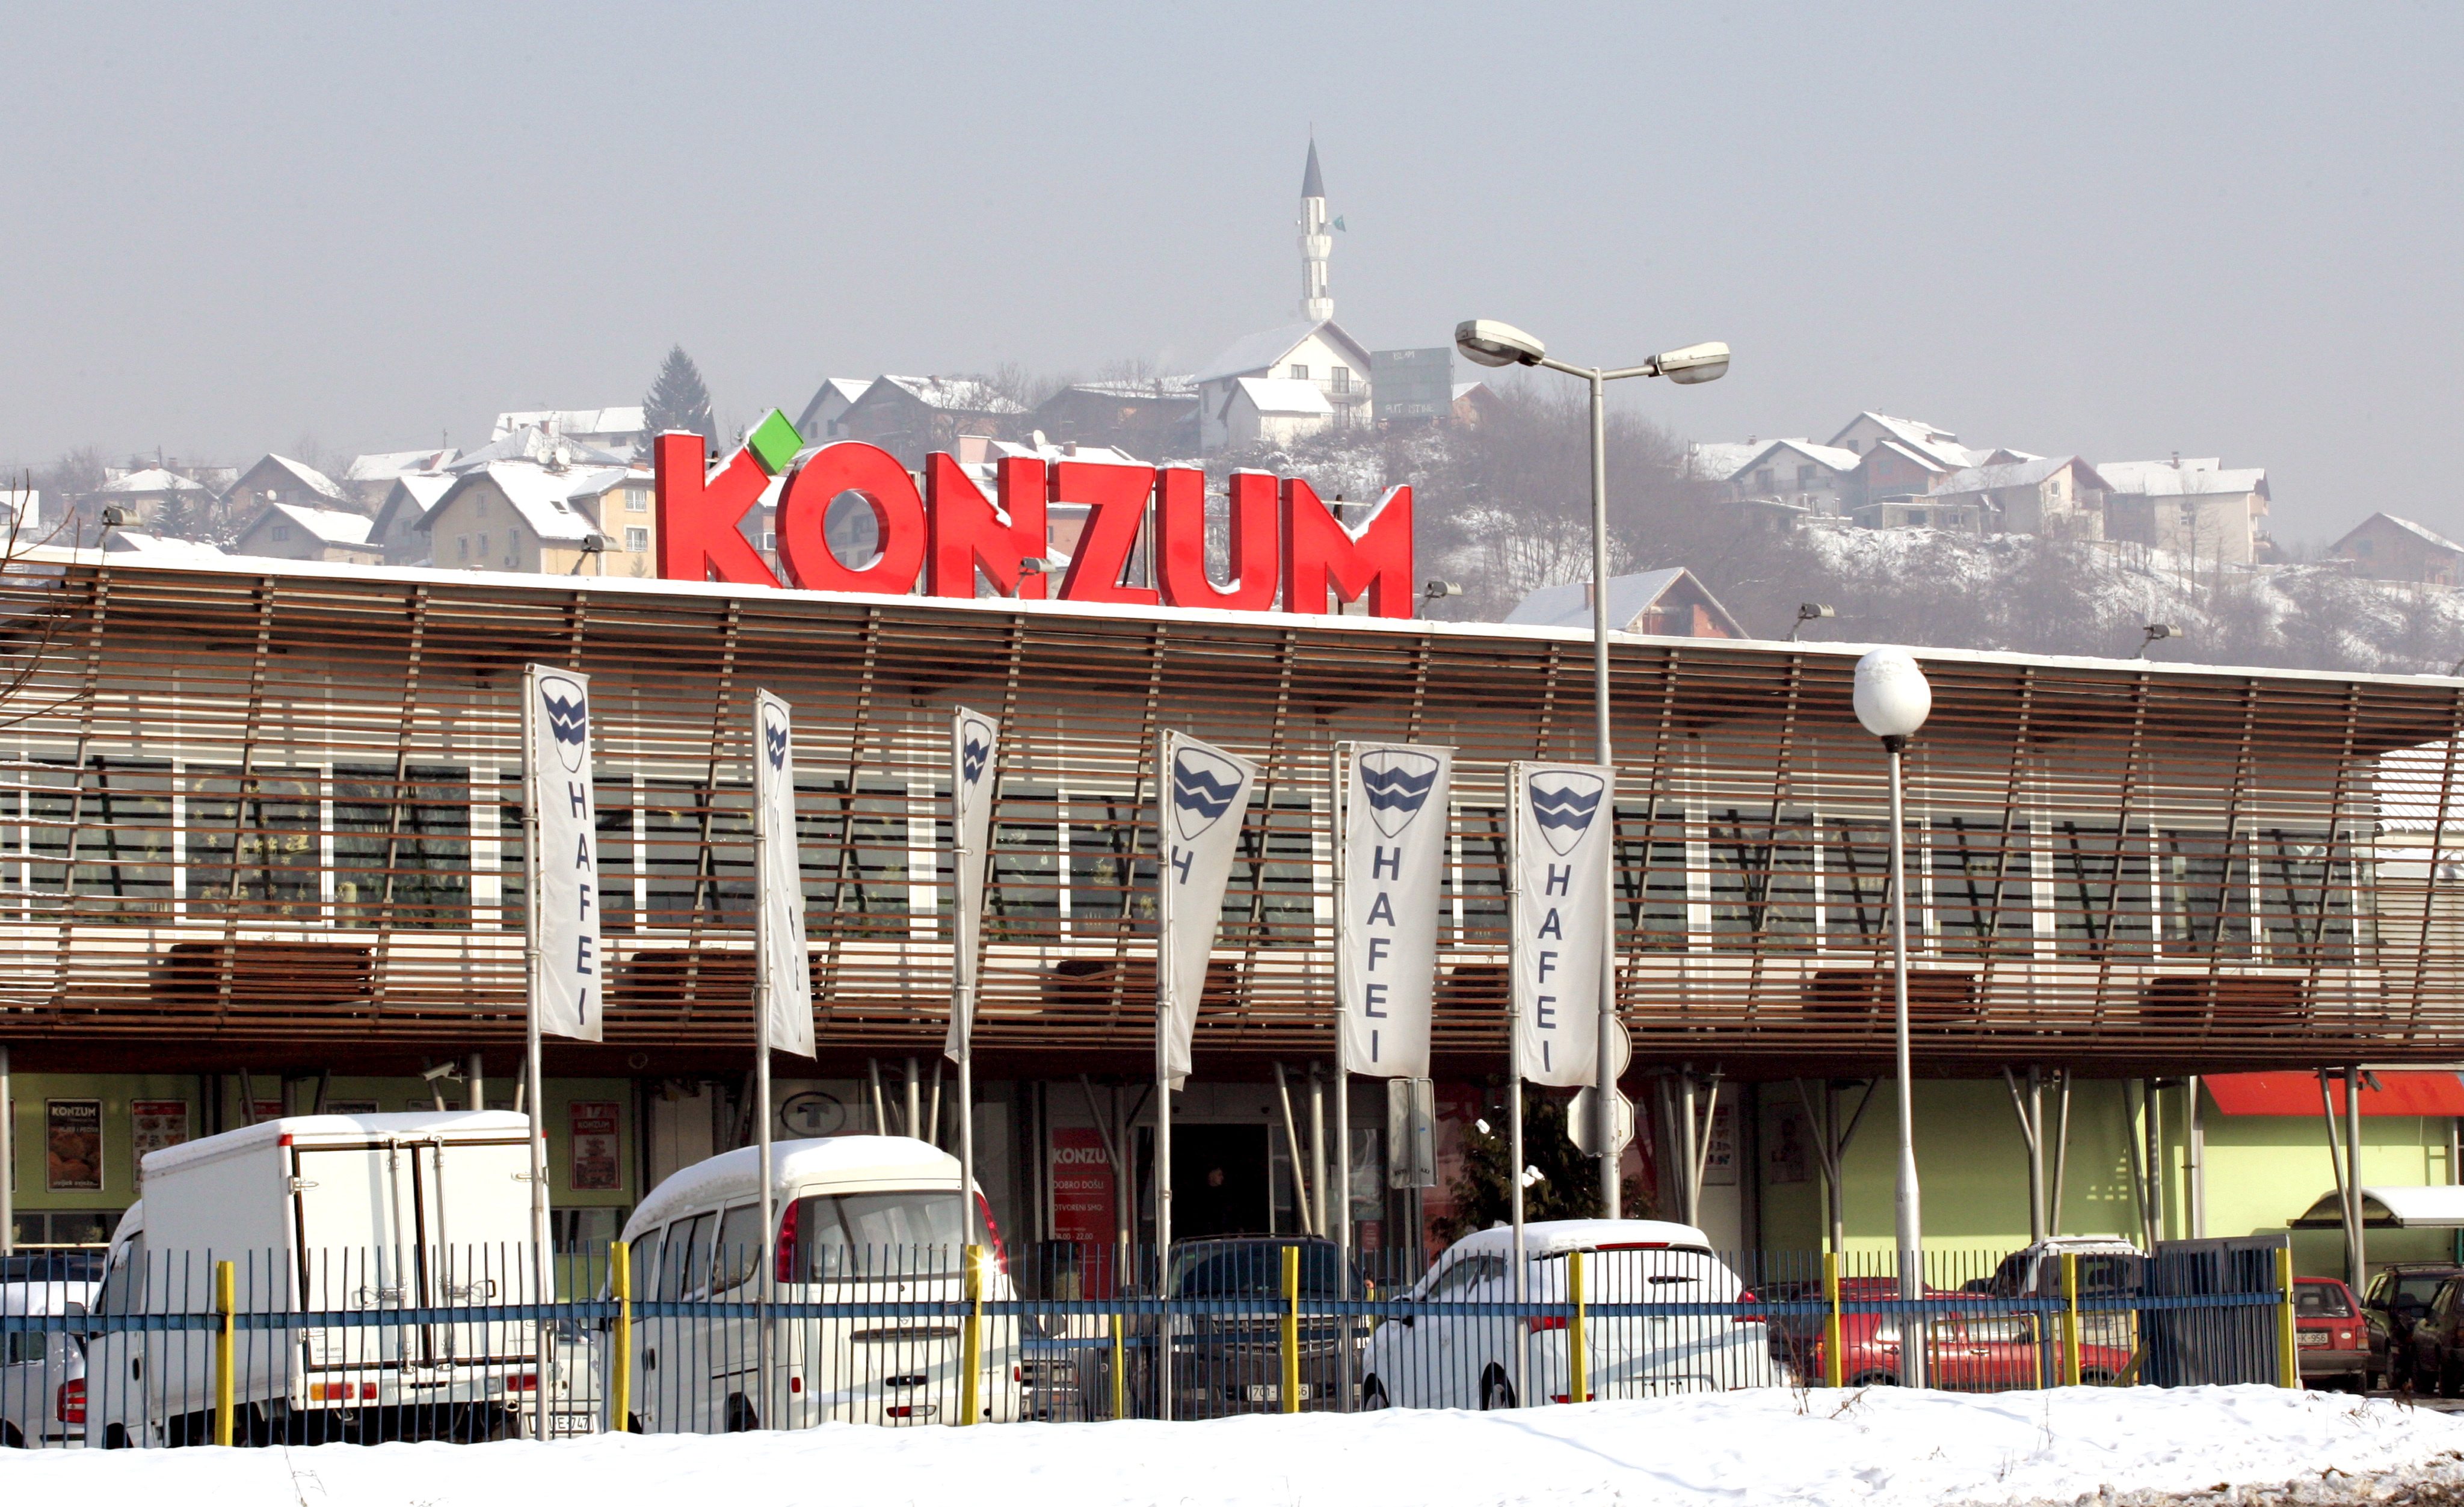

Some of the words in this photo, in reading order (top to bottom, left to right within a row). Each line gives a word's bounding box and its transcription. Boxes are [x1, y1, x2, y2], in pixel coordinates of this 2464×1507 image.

[655, 409, 1412, 620] KONZUM
[568, 780, 592, 1026] HAFEI
[1365, 845, 1401, 1063] HAFEI
[1538, 863, 1571, 1073] HAFEI
[52, 1106, 96, 1117] KONZUM
[1053, 1147, 1109, 1164] KONZU
[1054, 1180, 1080, 1189] DOBRO
[1082, 1179, 1104, 1189] DOŠLI
